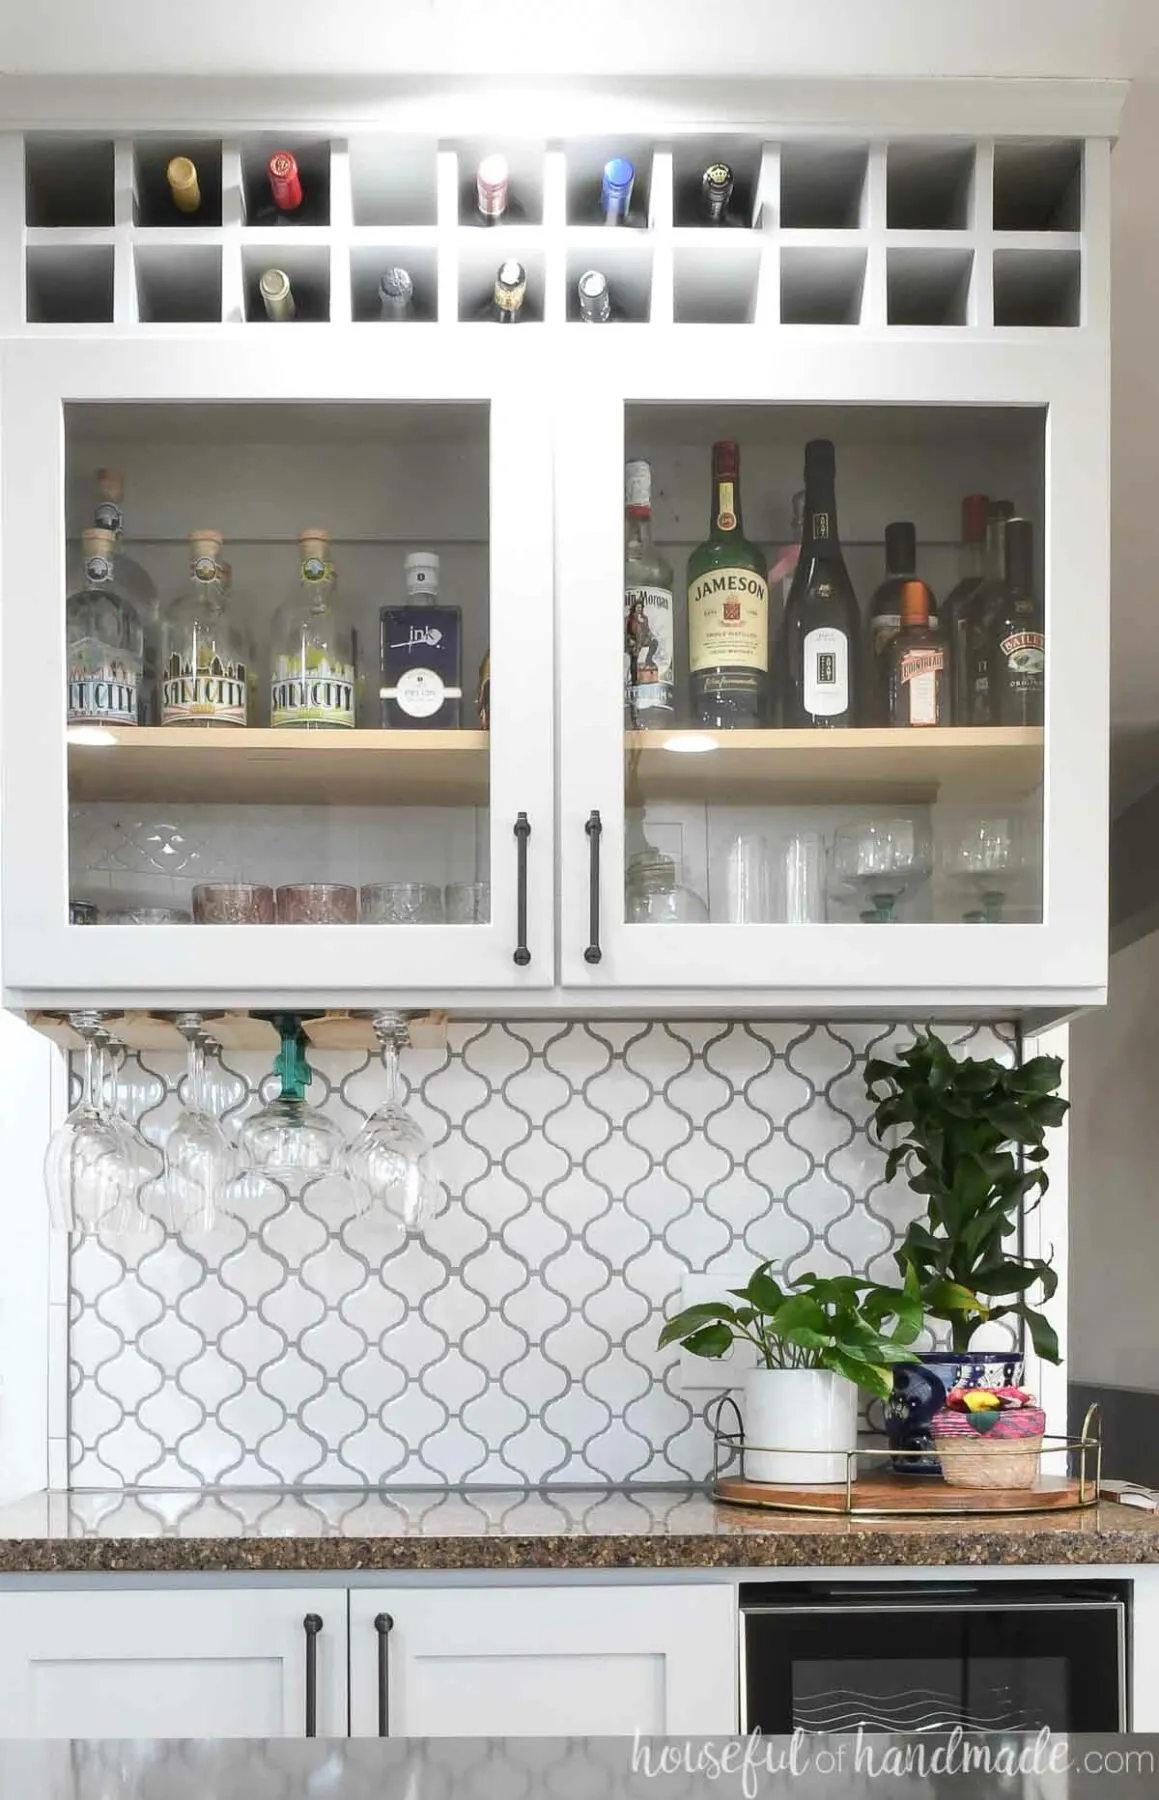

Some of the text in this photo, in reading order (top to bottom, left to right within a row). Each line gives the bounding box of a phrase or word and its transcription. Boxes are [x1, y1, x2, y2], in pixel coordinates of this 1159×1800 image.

[639, 590, 668, 609] Morgan
[695, 576, 764, 601] JAMESON
[95, 683, 133, 713] CITY
[164, 679, 243, 708] SALT CITY
[273, 681, 352, 711] SALT CITY
